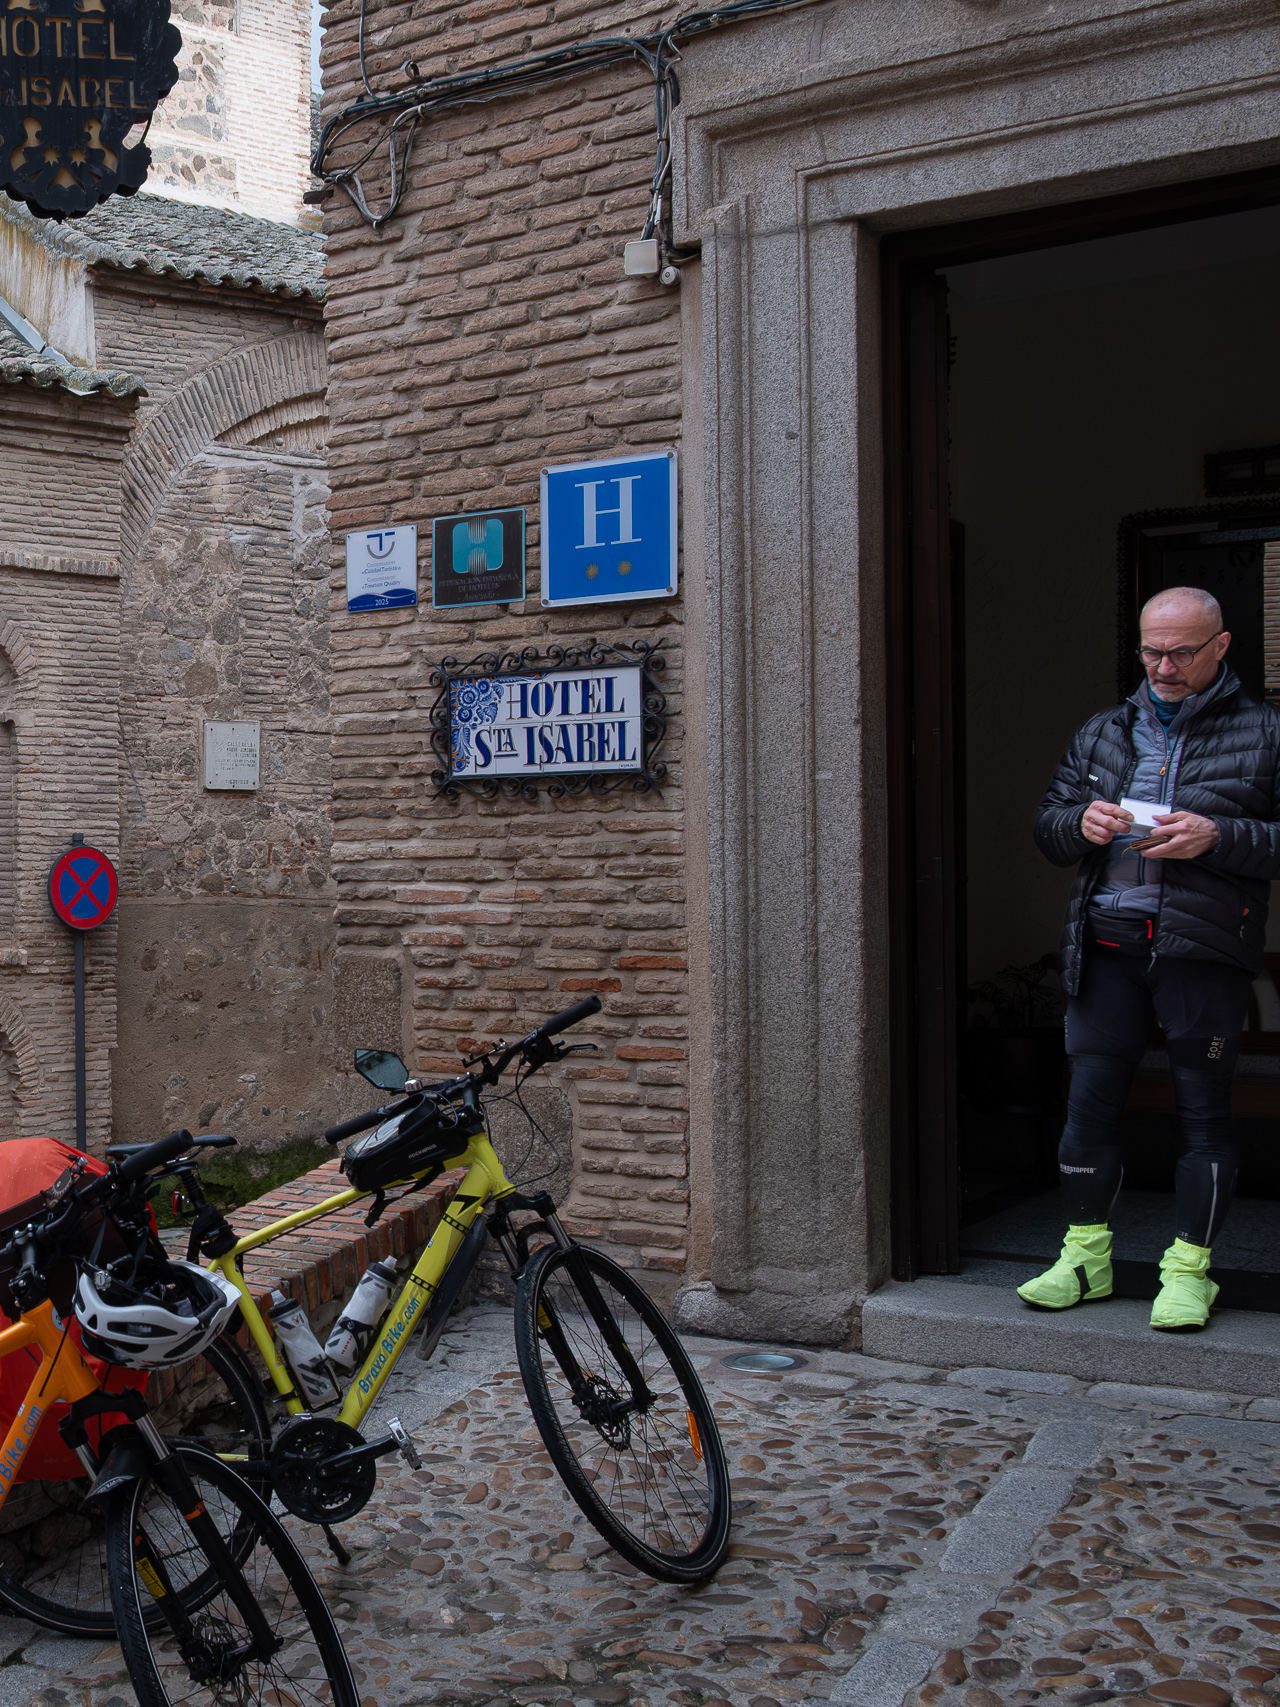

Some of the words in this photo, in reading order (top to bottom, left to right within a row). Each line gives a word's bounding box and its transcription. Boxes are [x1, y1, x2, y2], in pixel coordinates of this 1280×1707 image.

[21, 74, 150, 109] ISABEL
[574, 475, 642, 549] H
[506, 676, 625, 720] HOTEL
[522, 720, 637, 771] ISABEL
[1207, 1036, 1221, 1058] GORE
[358, 1353, 387, 1394] Bravo
[381, 1297, 421, 1353] Bike.com
